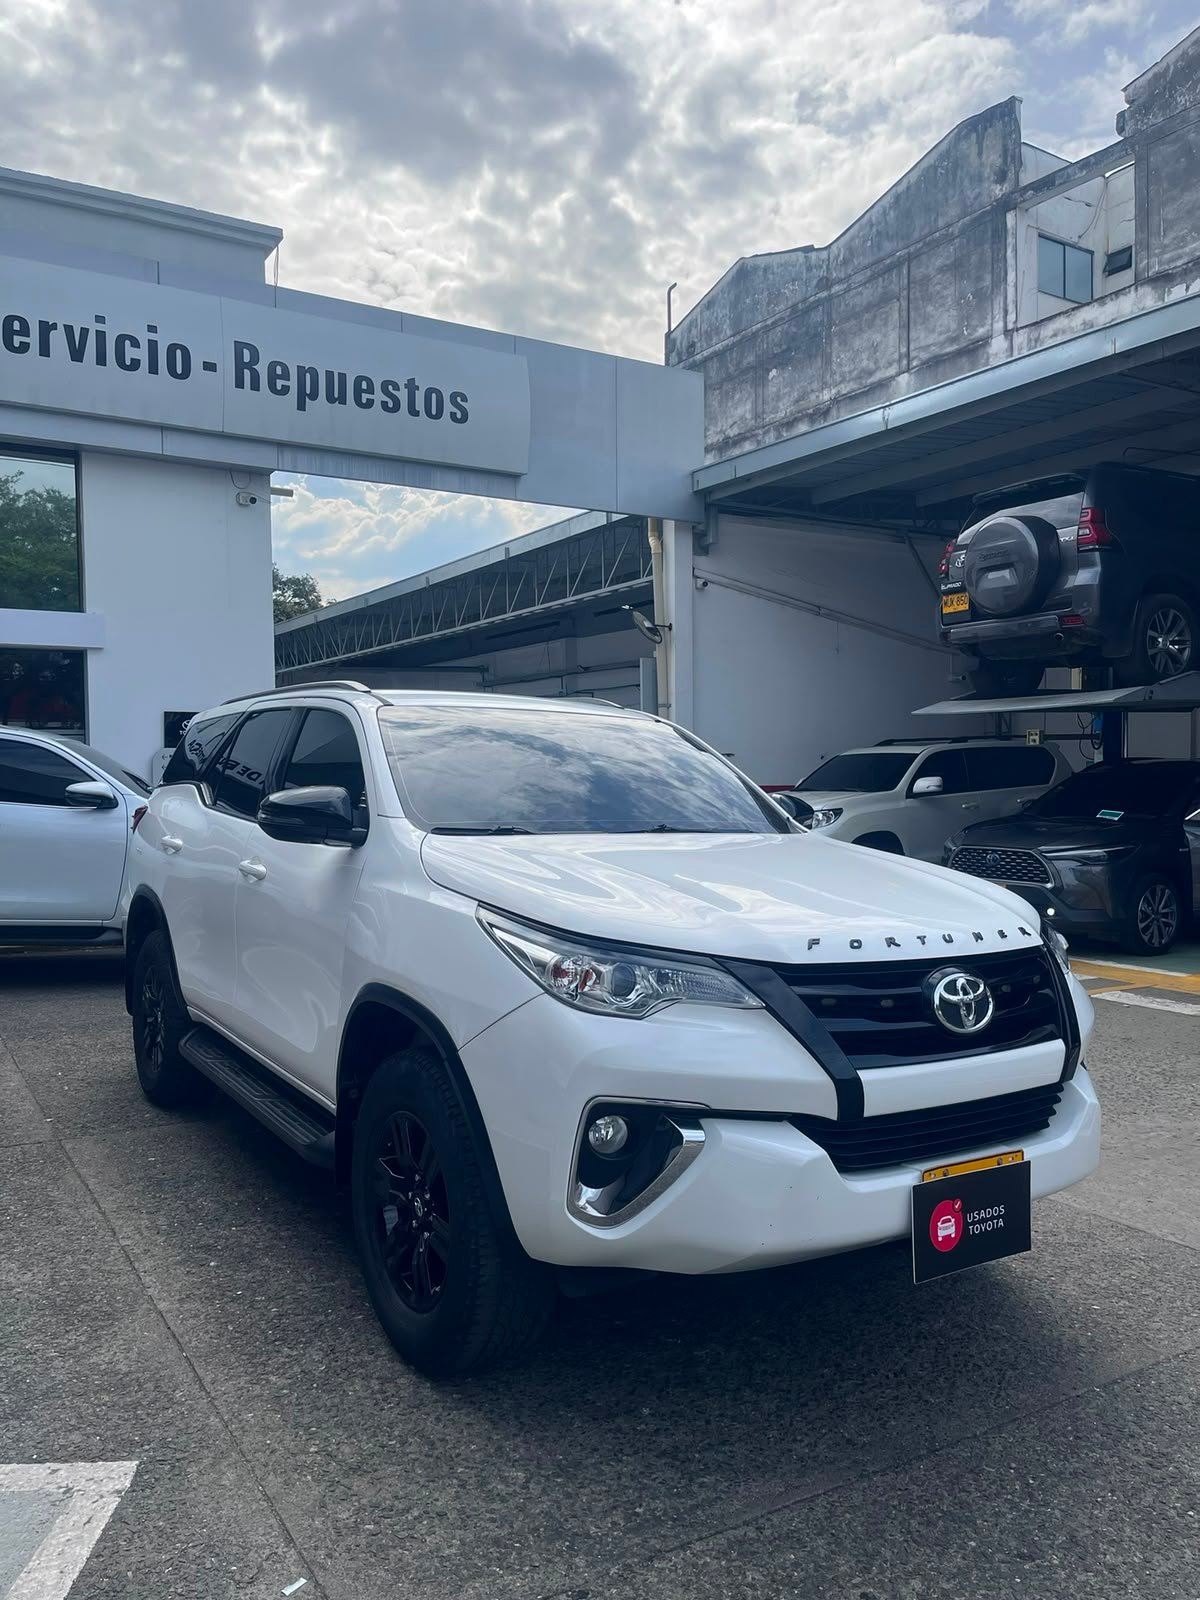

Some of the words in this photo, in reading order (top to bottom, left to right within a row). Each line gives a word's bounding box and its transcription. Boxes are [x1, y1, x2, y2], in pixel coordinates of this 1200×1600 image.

[233, 340, 469, 425] Repuestos
[956, 594, 968, 606] 850
[807, 926, 1032, 951] FORTUNER
[966, 1204, 1005, 1223] USADOS
[968, 1218, 1005, 1235] TOYOTA
